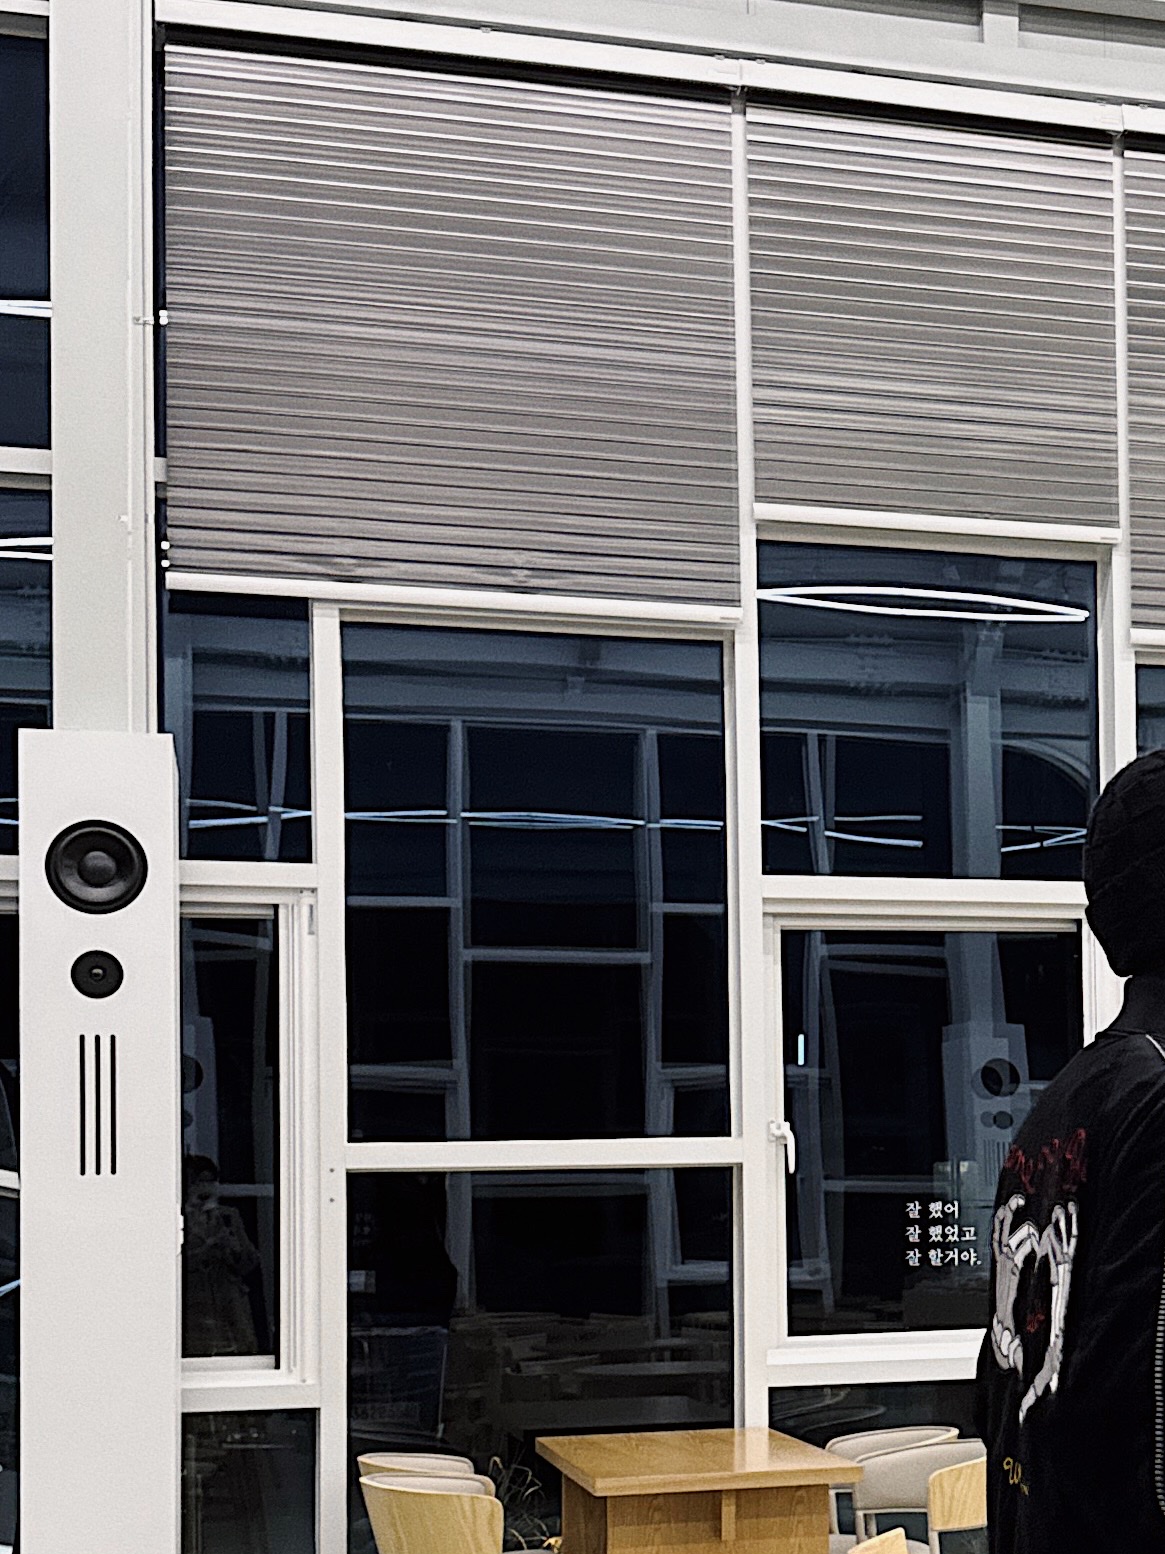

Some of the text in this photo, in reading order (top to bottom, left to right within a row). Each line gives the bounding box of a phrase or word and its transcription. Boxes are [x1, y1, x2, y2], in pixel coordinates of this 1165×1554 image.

[905, 1200, 959, 1219] 잘 했어
[905, 1224, 977, 1243] 잘 했었고
[905, 1248, 982, 1267] 잘 할거야.
